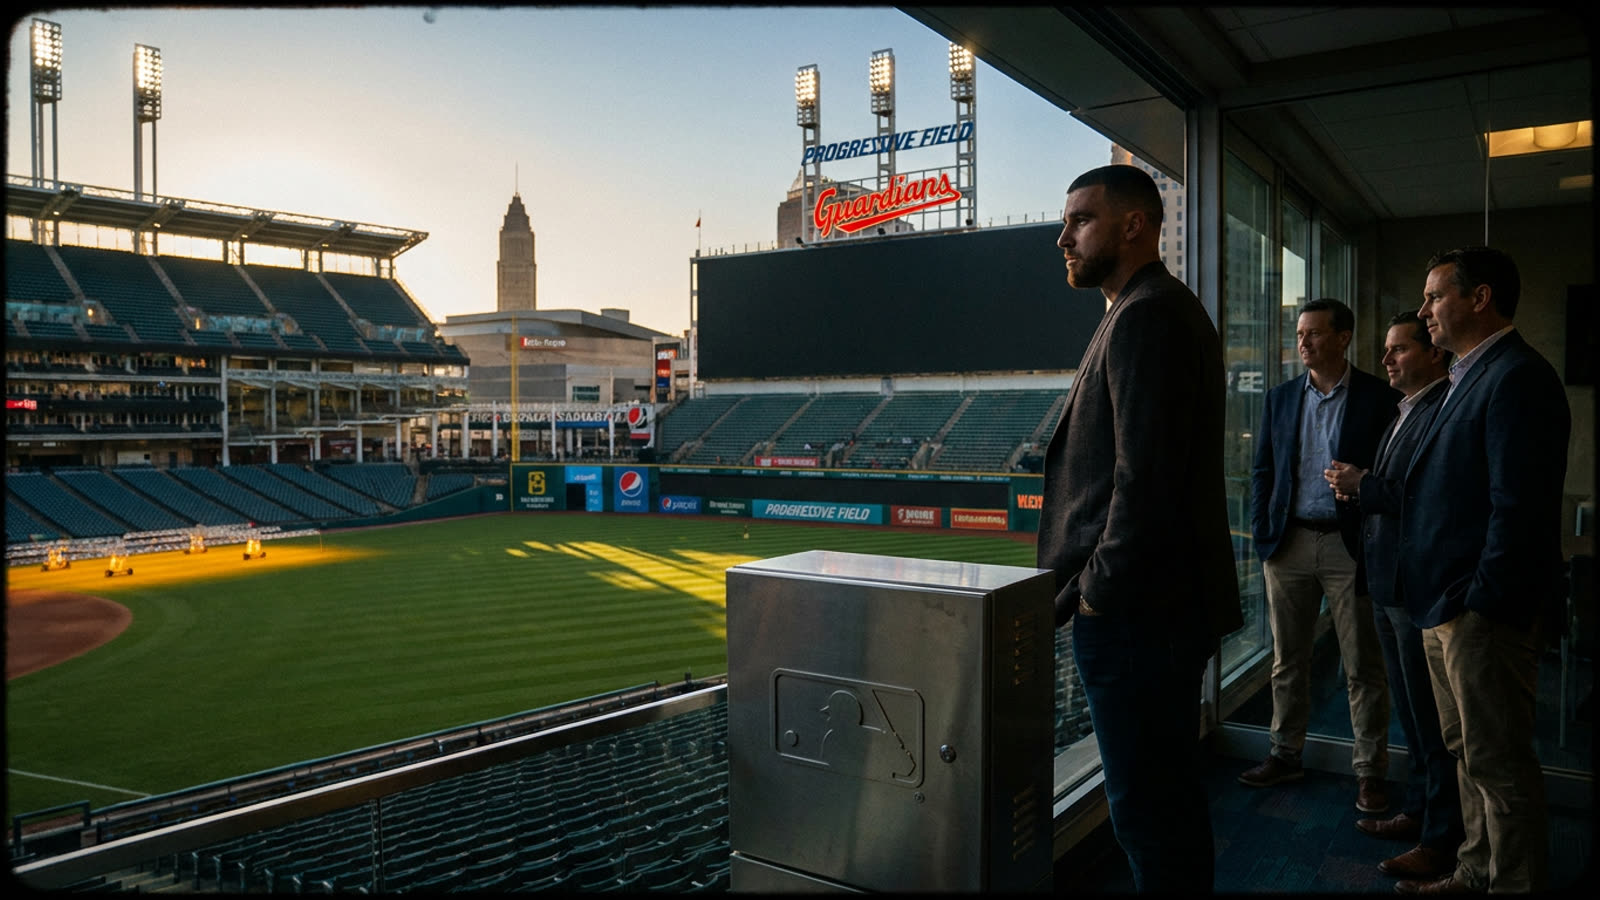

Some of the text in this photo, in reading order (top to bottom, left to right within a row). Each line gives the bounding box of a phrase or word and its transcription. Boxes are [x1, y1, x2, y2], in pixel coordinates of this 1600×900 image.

[920, 122, 974, 148] FIELD
[813, 173, 962, 238] Guardians
[837, 506, 871, 520] FIELD
